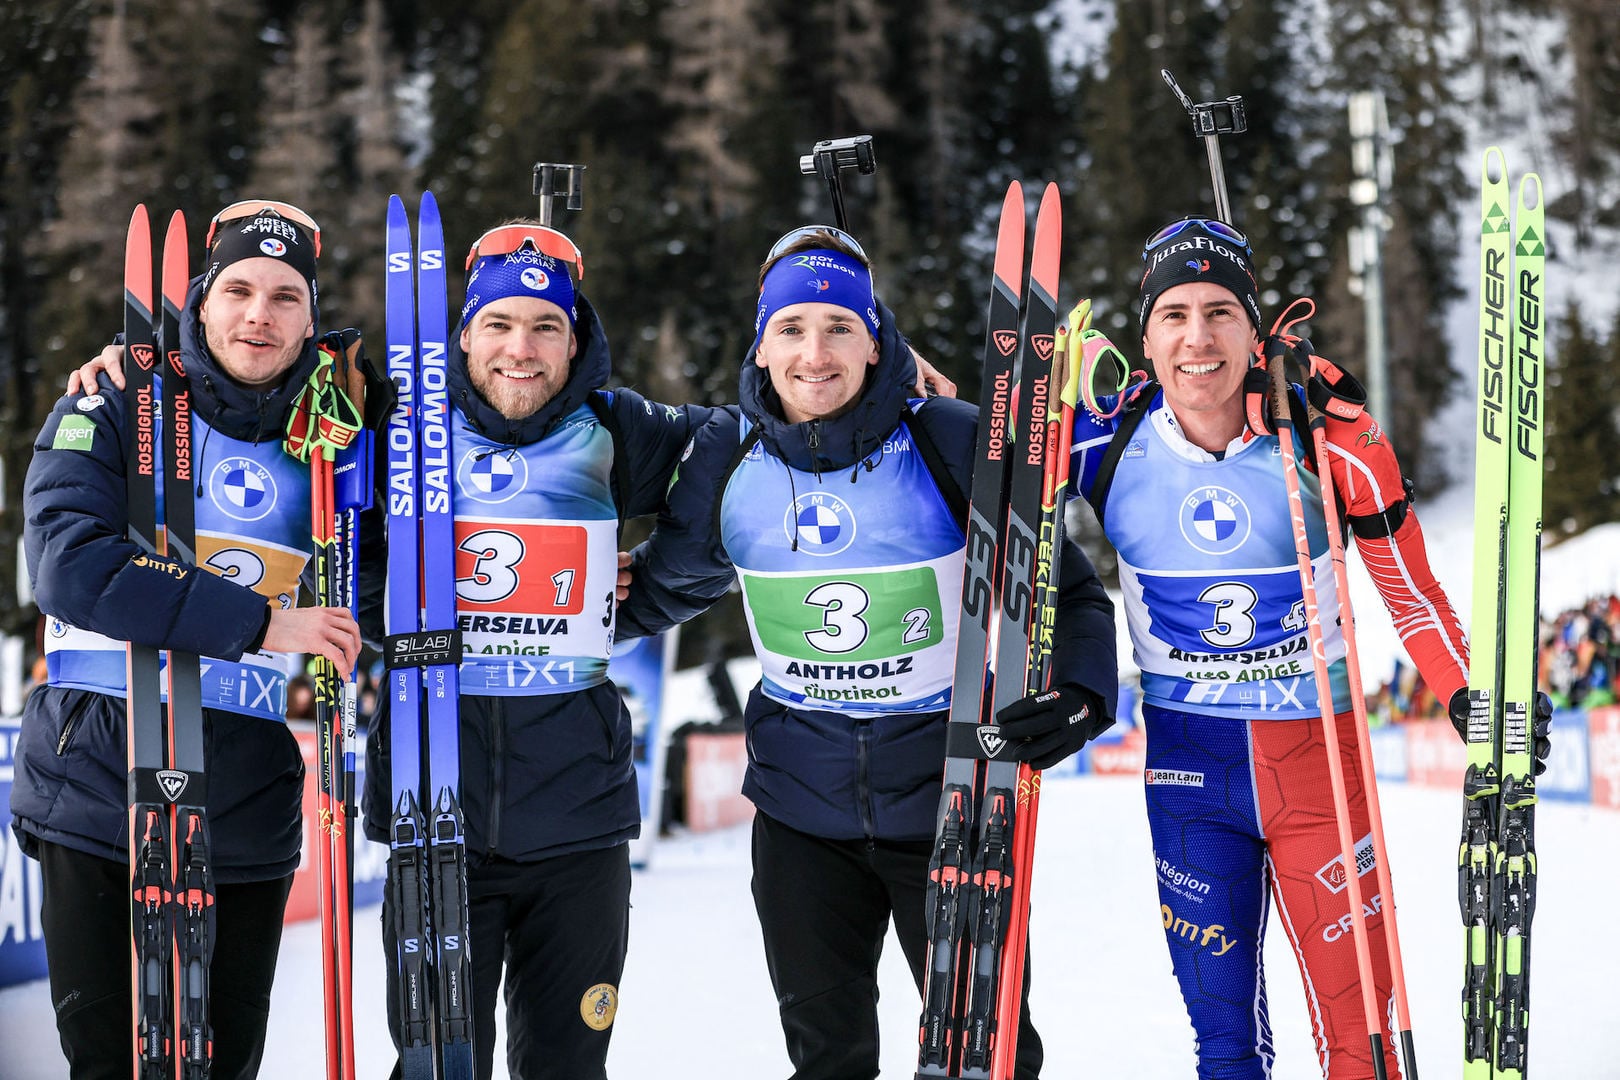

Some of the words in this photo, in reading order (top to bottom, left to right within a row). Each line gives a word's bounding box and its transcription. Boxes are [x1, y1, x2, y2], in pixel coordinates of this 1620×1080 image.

[502, 255, 555, 272] AVORIAZ
[809, 260, 856, 278] ENERGIE
[1150, 236, 1246, 275] JuraFlore
[1482, 247, 1505, 444] FISCHER
[1516, 269, 1540, 461] FISCHER
[137, 384, 153, 476] ROSSIGNOL
[175, 390, 191, 481] ROSSIGNOL
[389, 344, 414, 517] SALOMON
[421, 341, 450, 514] SALOMON
[987, 369, 1010, 462] ROSSIGNOL
[1027, 374, 1049, 466] ROSSIGNOL
[1337, 405, 1360, 417] ONE
[220, 460, 270, 481] BMW
[792, 494, 844, 514] BMW
[1186, 488, 1240, 510] BMW
[455, 528, 527, 604] 3
[1035, 521, 1052, 588] LEKI
[551, 568, 576, 607] 1
[602, 591, 614, 629] 3
[801, 579, 872, 655] 3
[900, 606, 931, 645] 2
[1042, 586, 1058, 655] LEKI
[1197, 580, 1259, 649] 3
[393, 652, 450, 664] SELECT
[785, 655, 913, 680] ANTHOLZ
[1160, 860, 1211, 895] Région
